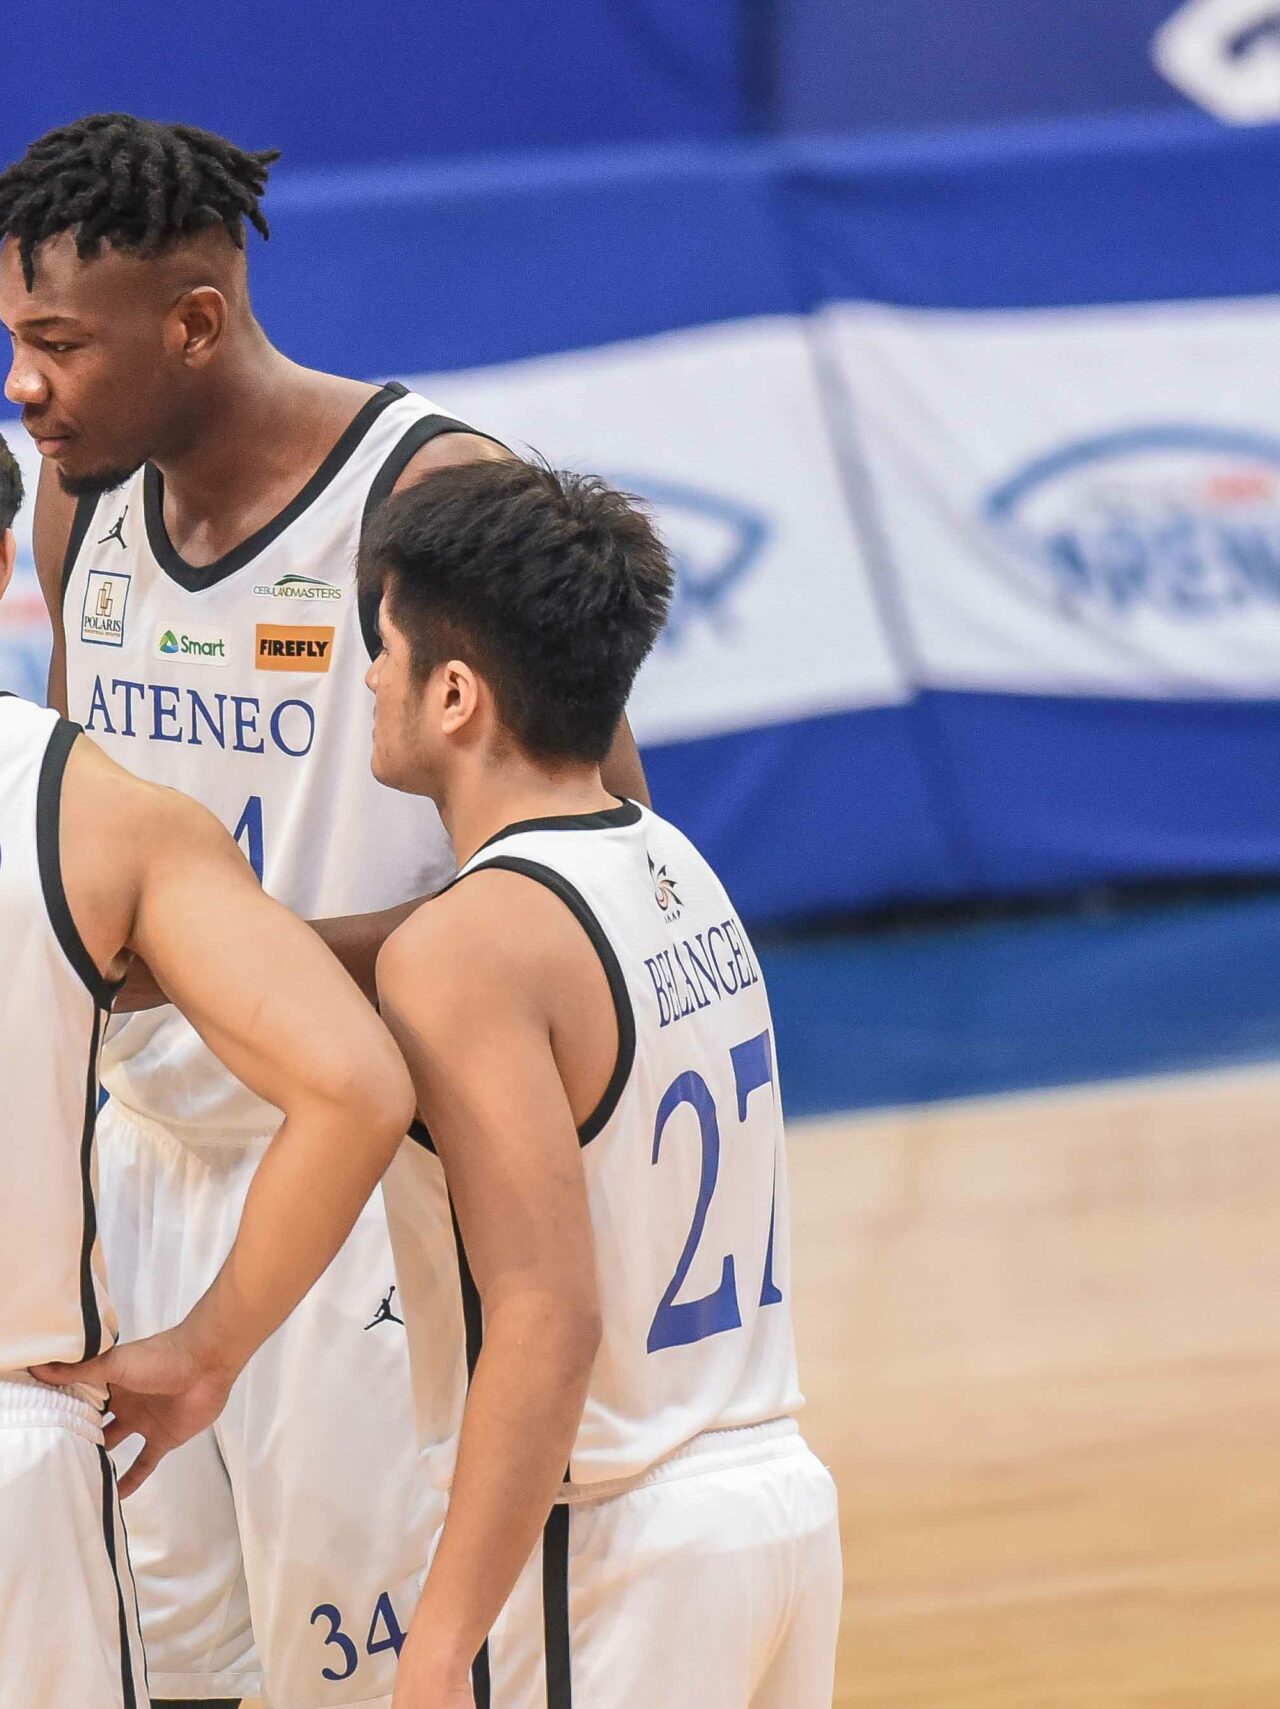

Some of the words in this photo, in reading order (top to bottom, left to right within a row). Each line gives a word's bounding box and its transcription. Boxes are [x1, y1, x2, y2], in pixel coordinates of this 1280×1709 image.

[84, 616, 121, 632] POLARIS
[181, 635, 225, 657] Smart
[260, 639, 329, 657] FIREFLY
[84, 673, 315, 757] ATENEO
[647, 1028, 783, 1355] 27
[310, 1591, 407, 1681] 34
